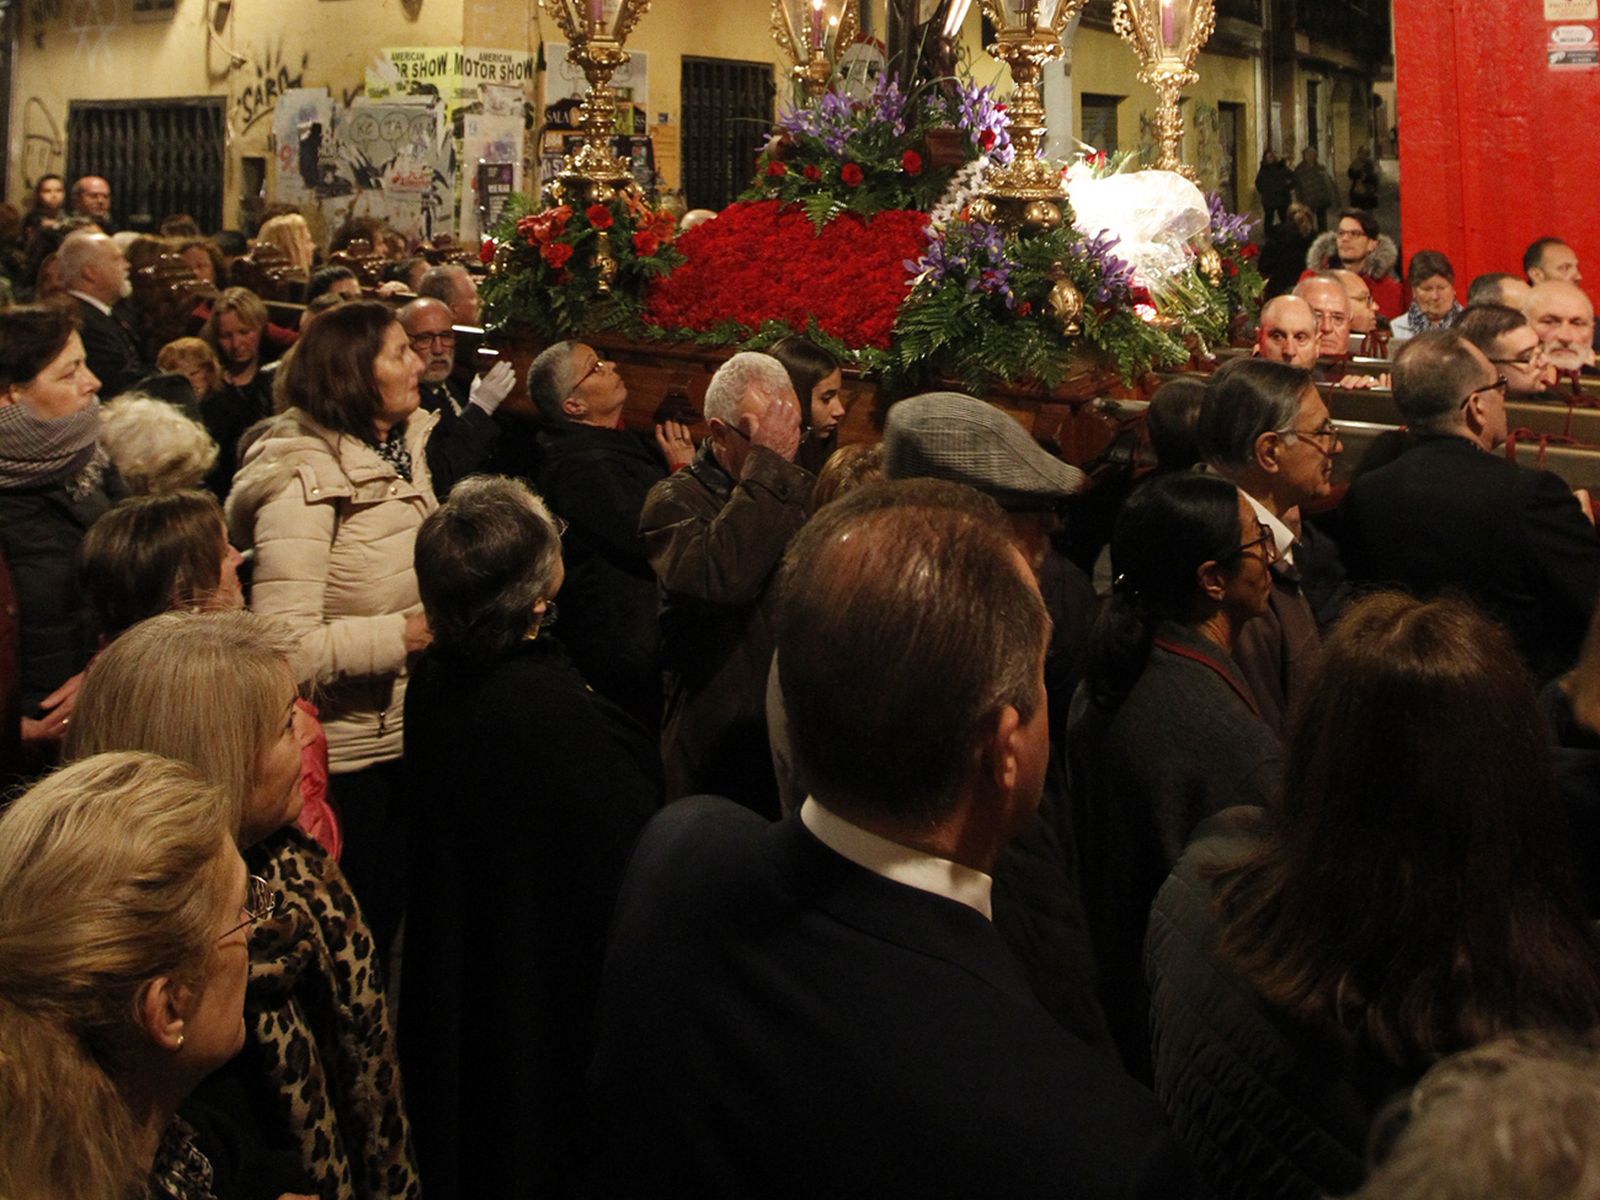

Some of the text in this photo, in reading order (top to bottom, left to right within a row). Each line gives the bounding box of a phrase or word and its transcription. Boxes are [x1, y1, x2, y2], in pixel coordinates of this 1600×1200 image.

[391, 51, 425, 60] AMERICAN
[479, 52, 512, 63] AMERICAN
[412, 52, 448, 78] SHOW
[454, 52, 496, 80] MOTOR
[499, 56, 534, 81] SHOW
[546, 110, 569, 124] SALA
